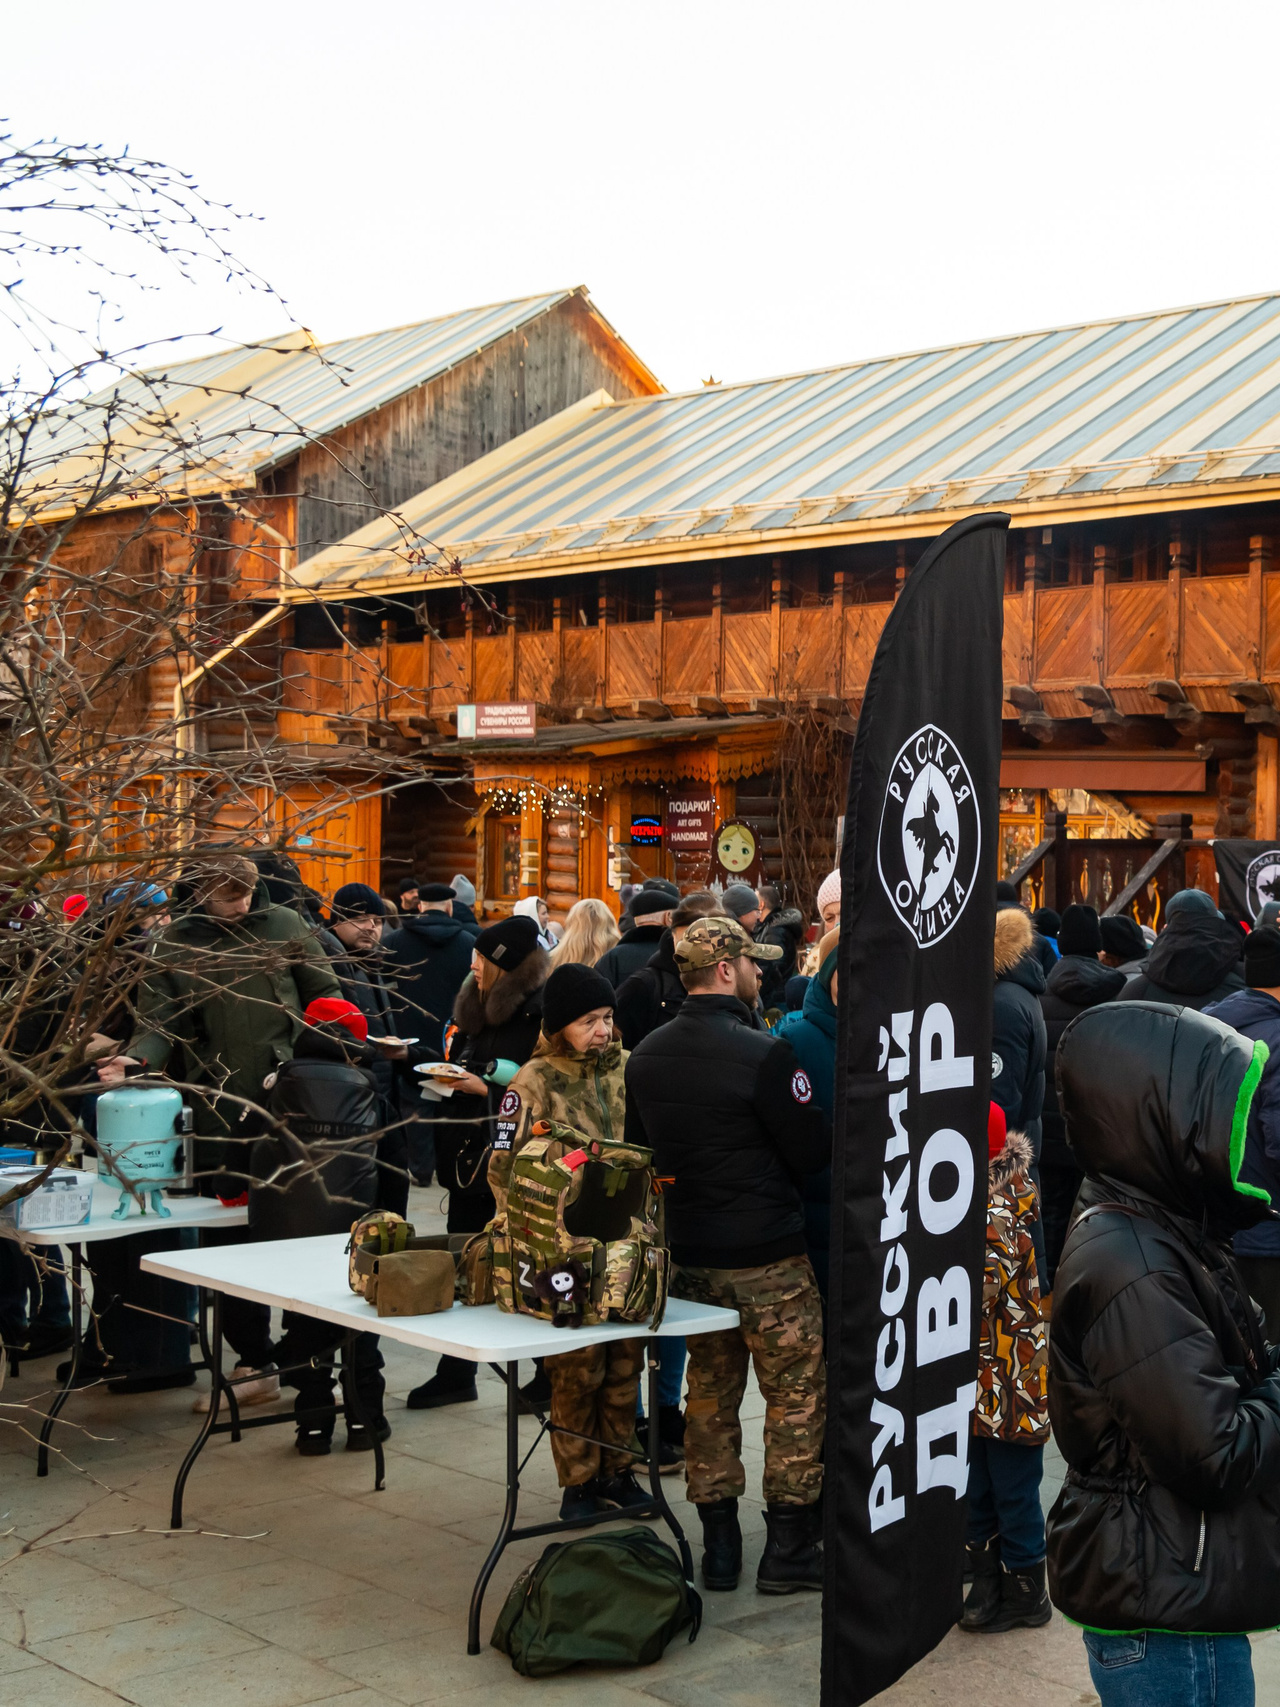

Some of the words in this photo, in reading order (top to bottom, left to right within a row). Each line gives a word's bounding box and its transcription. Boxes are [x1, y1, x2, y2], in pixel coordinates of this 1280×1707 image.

[889, 731, 971, 804] РУССКАЯ
[669, 801, 710, 814] ПОДАРКИ
[677, 819, 687, 827] ART
[688, 818, 702, 827] GIFTS
[630, 825, 663, 836] ОТКРЫТО
[671, 832, 708, 841] HANDMADE
[916, 1001, 978, 1500] ДВОР
[868, 1009, 915, 1534] РУССКИЙ
